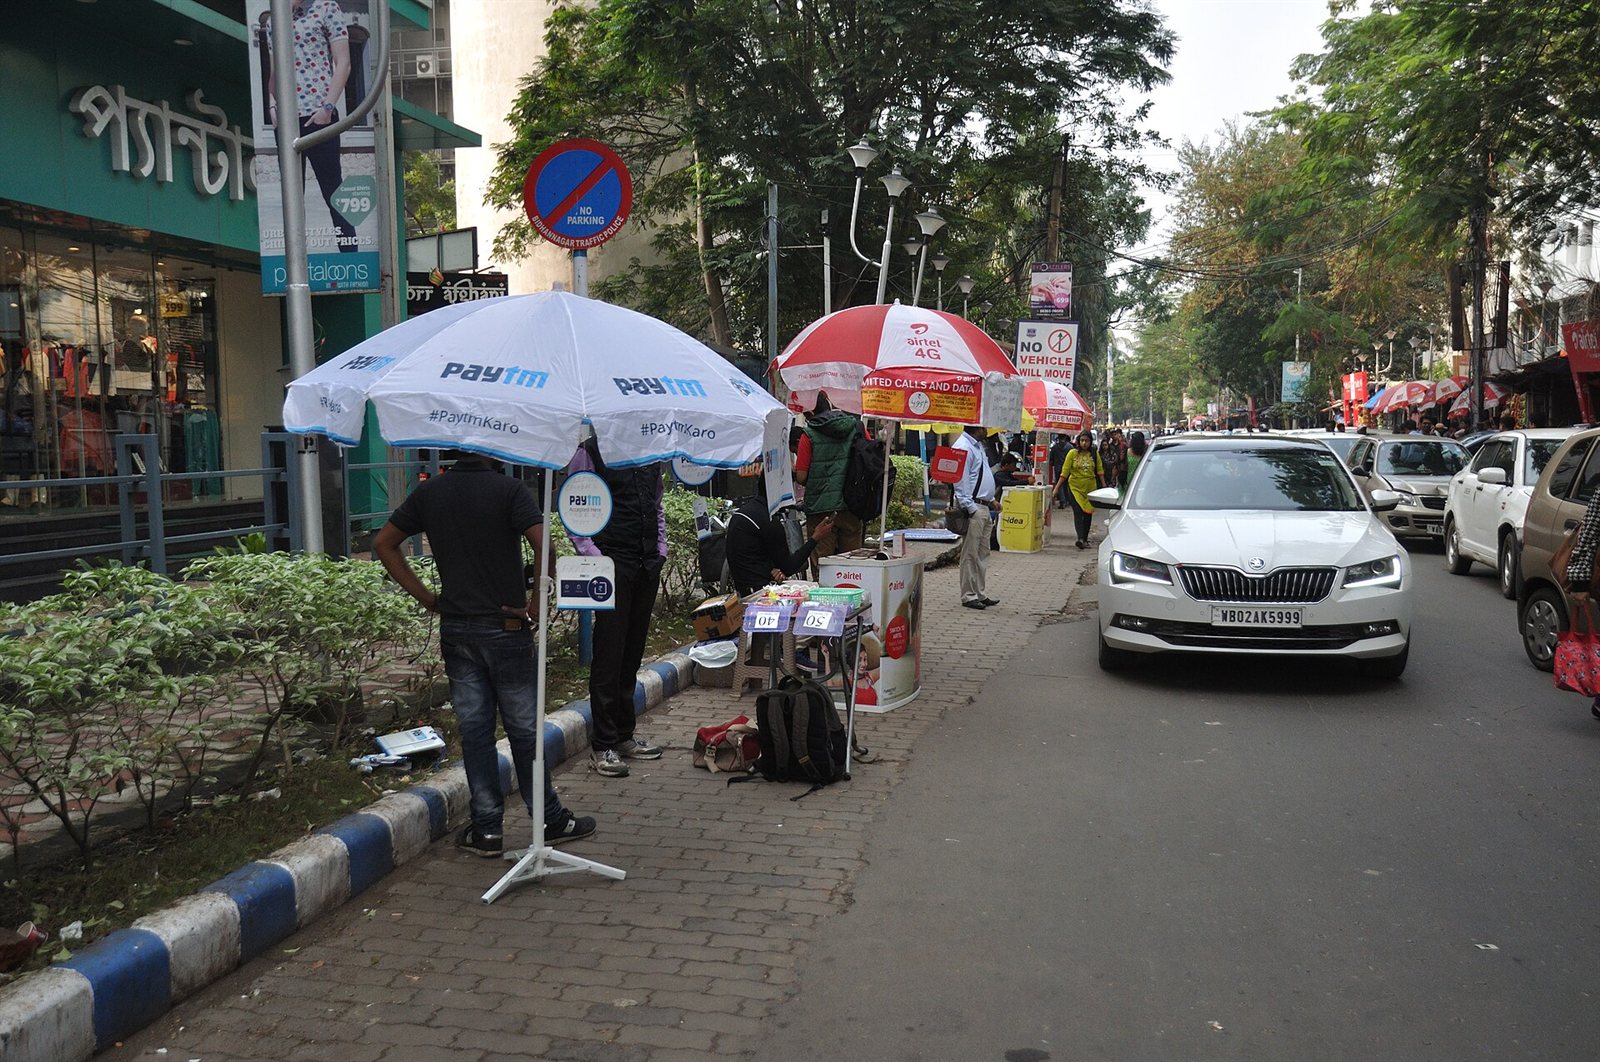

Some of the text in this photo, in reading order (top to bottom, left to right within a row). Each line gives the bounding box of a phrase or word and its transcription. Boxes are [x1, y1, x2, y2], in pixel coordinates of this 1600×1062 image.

[579, 206, 593, 216] NO
[567, 216, 605, 225] PARKING
[531, 215, 625, 248] BIDHANNAGAR TRAFFIC POLICE
[274, 260, 369, 287] ptaloons
[907, 337, 942, 348] airtel
[1020, 341, 1043, 353] NO
[914, 348, 942, 361] 4G
[1020, 355, 1073, 367] VEHICLE
[440, 361, 549, 389] Paytm
[1019, 368, 1072, 379] WILL MOVE
[612, 375, 708, 398] Paytm
[895, 378, 927, 389] CALLS
[928, 381, 950, 392] AND
[952, 383, 975, 394] DATA
[429, 409, 519, 434] #PaytmKaro
[1047, 414, 1064, 423] FREE
[640, 420, 716, 440] #PaytmKaro
[569, 495, 601, 506] Paytm
[1007, 516, 1024, 525] idea
[843, 571, 862, 580] airtel
[893, 580, 905, 590] airtel
[1221, 609, 1301, 625] WB02AK5999
